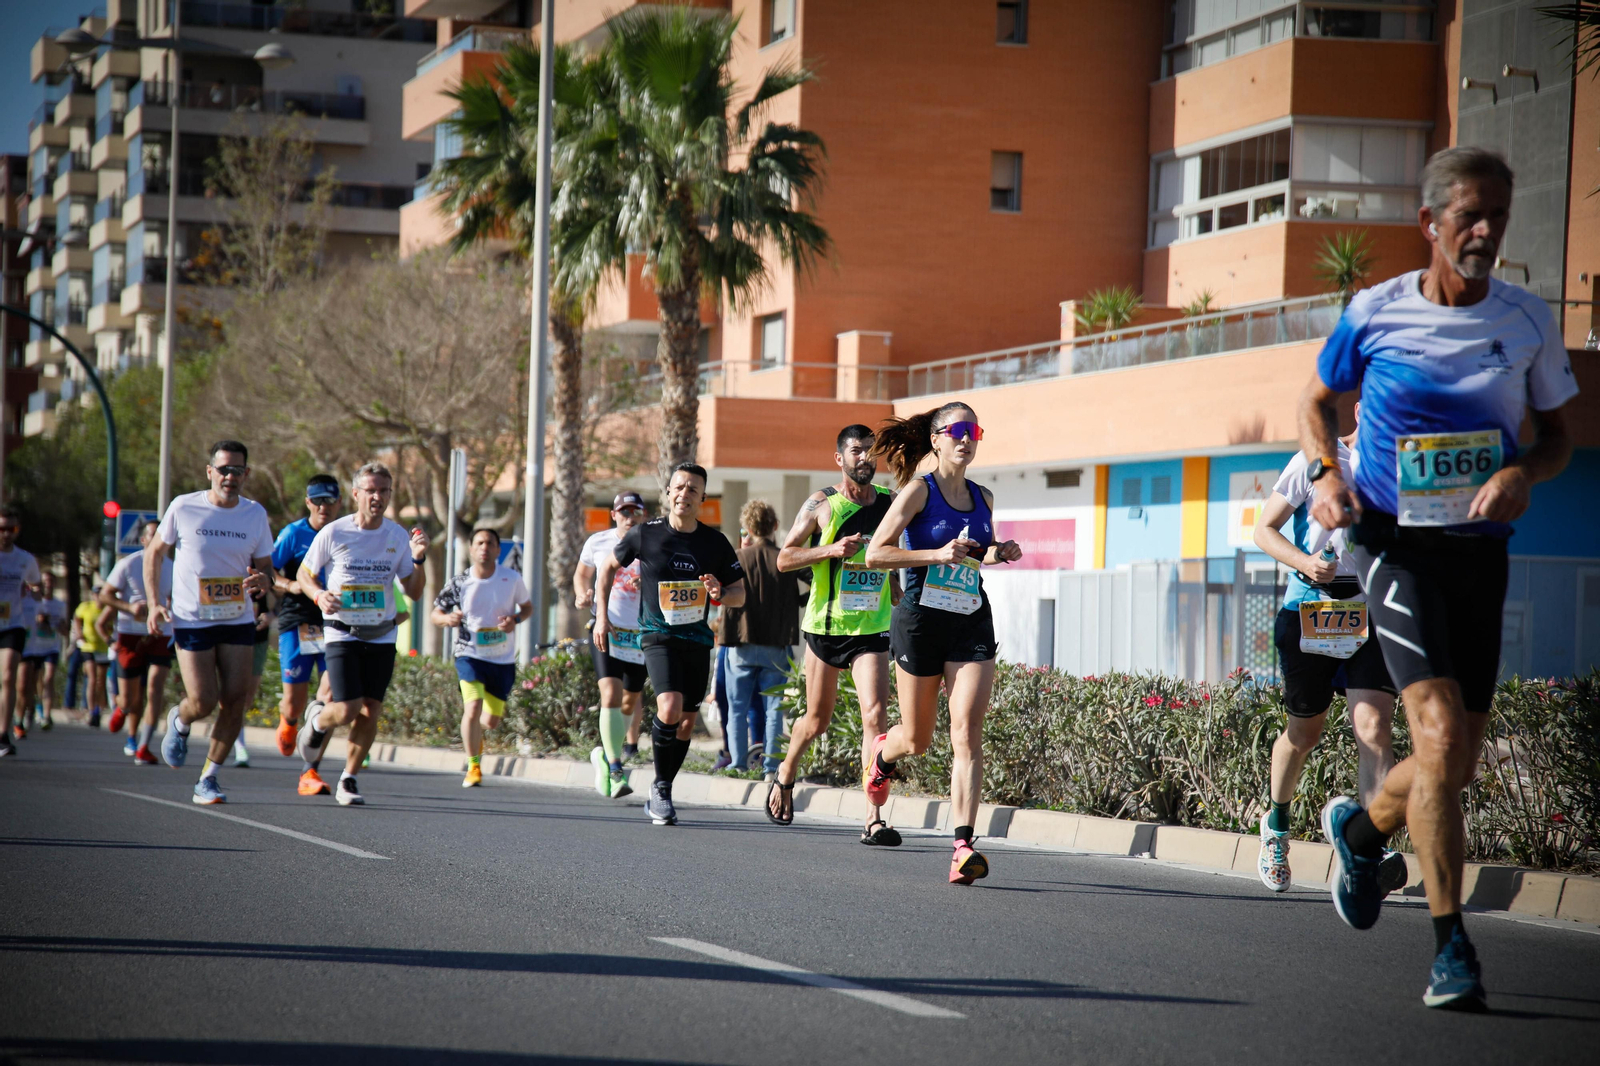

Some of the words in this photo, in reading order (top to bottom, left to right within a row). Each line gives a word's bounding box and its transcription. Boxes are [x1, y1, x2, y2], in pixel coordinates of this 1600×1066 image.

[1410, 447, 1492, 478] 1666
[195, 528, 247, 540] COSENTINO
[372, 564, 391, 572] 2024
[673, 560, 695, 570] VITA
[847, 571, 885, 586] 2095
[936, 563, 976, 587] 1745
[204, 583, 240, 597] 1205
[669, 588, 698, 602] 286
[350, 591, 377, 604] 118
[1308, 611, 1361, 628] 1775
